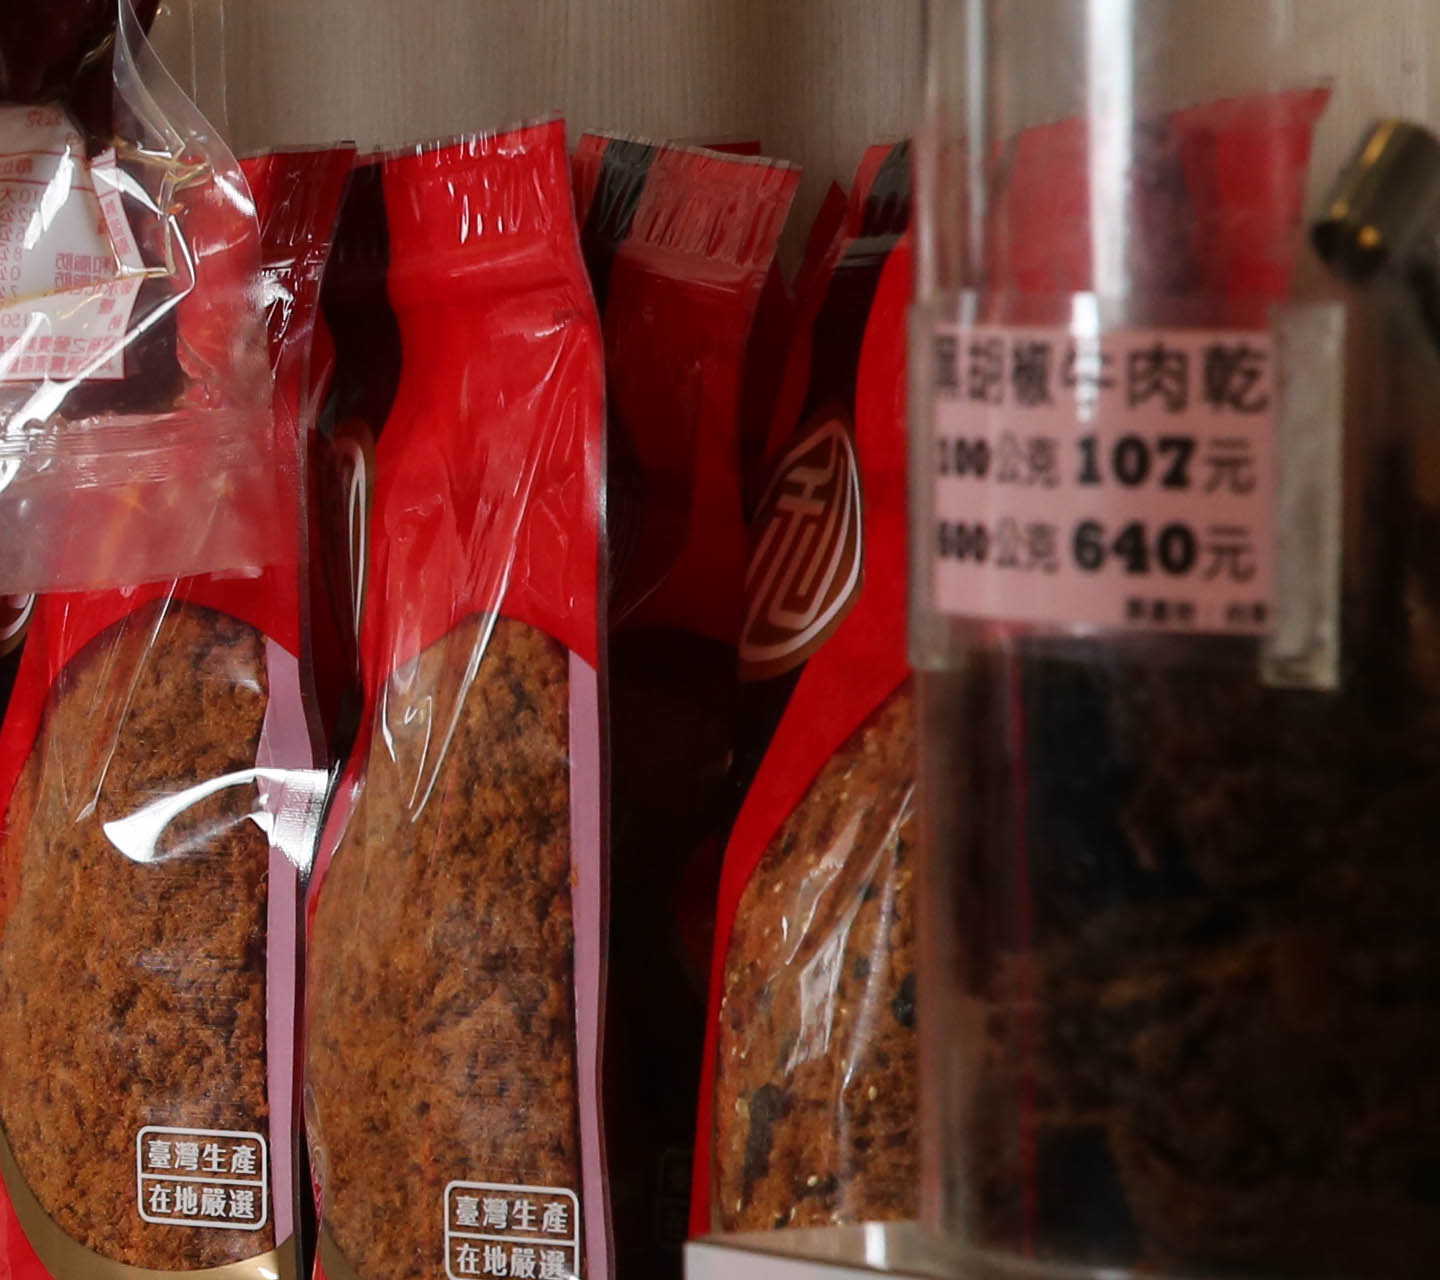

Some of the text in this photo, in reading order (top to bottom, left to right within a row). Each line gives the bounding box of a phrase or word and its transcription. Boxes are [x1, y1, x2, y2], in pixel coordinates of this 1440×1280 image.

[1077, 436, 1256, 494] 107元
[1072, 522, 1256, 582] 640元
[147, 1139, 257, 1175] 臺灣生產
[148, 1184, 256, 1219] 在地嚴選
[455, 1195, 568, 1234] 臺灣生產
[456, 1243, 568, 1280] 在地嚴選
